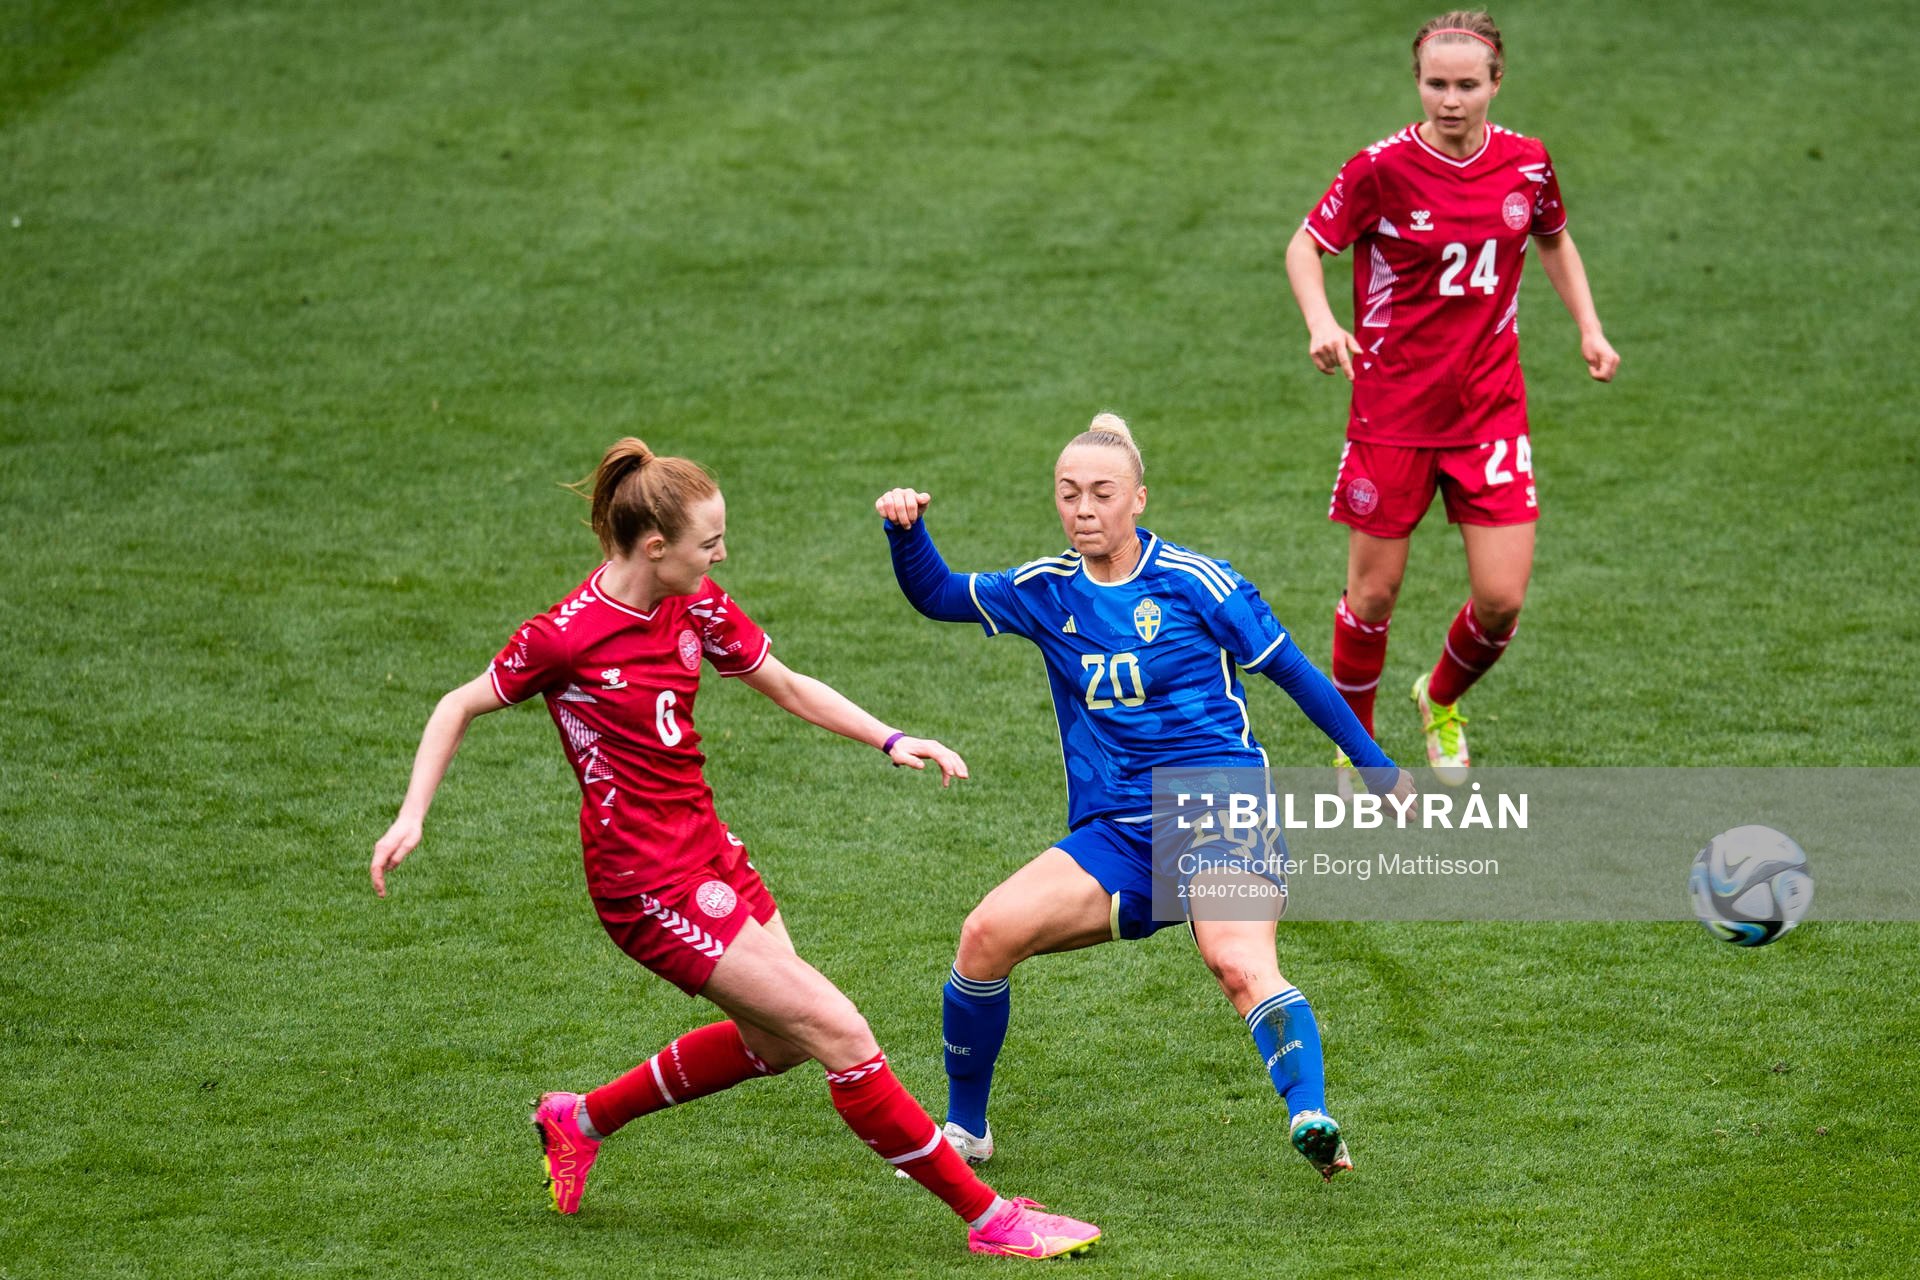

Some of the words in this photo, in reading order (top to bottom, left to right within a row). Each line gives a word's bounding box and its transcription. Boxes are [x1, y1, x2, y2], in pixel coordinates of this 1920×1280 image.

[1438, 238, 1500, 297] 24
[1480, 434, 1534, 486] 24
[1081, 652, 1147, 711] 20
[656, 690, 683, 747] 6
